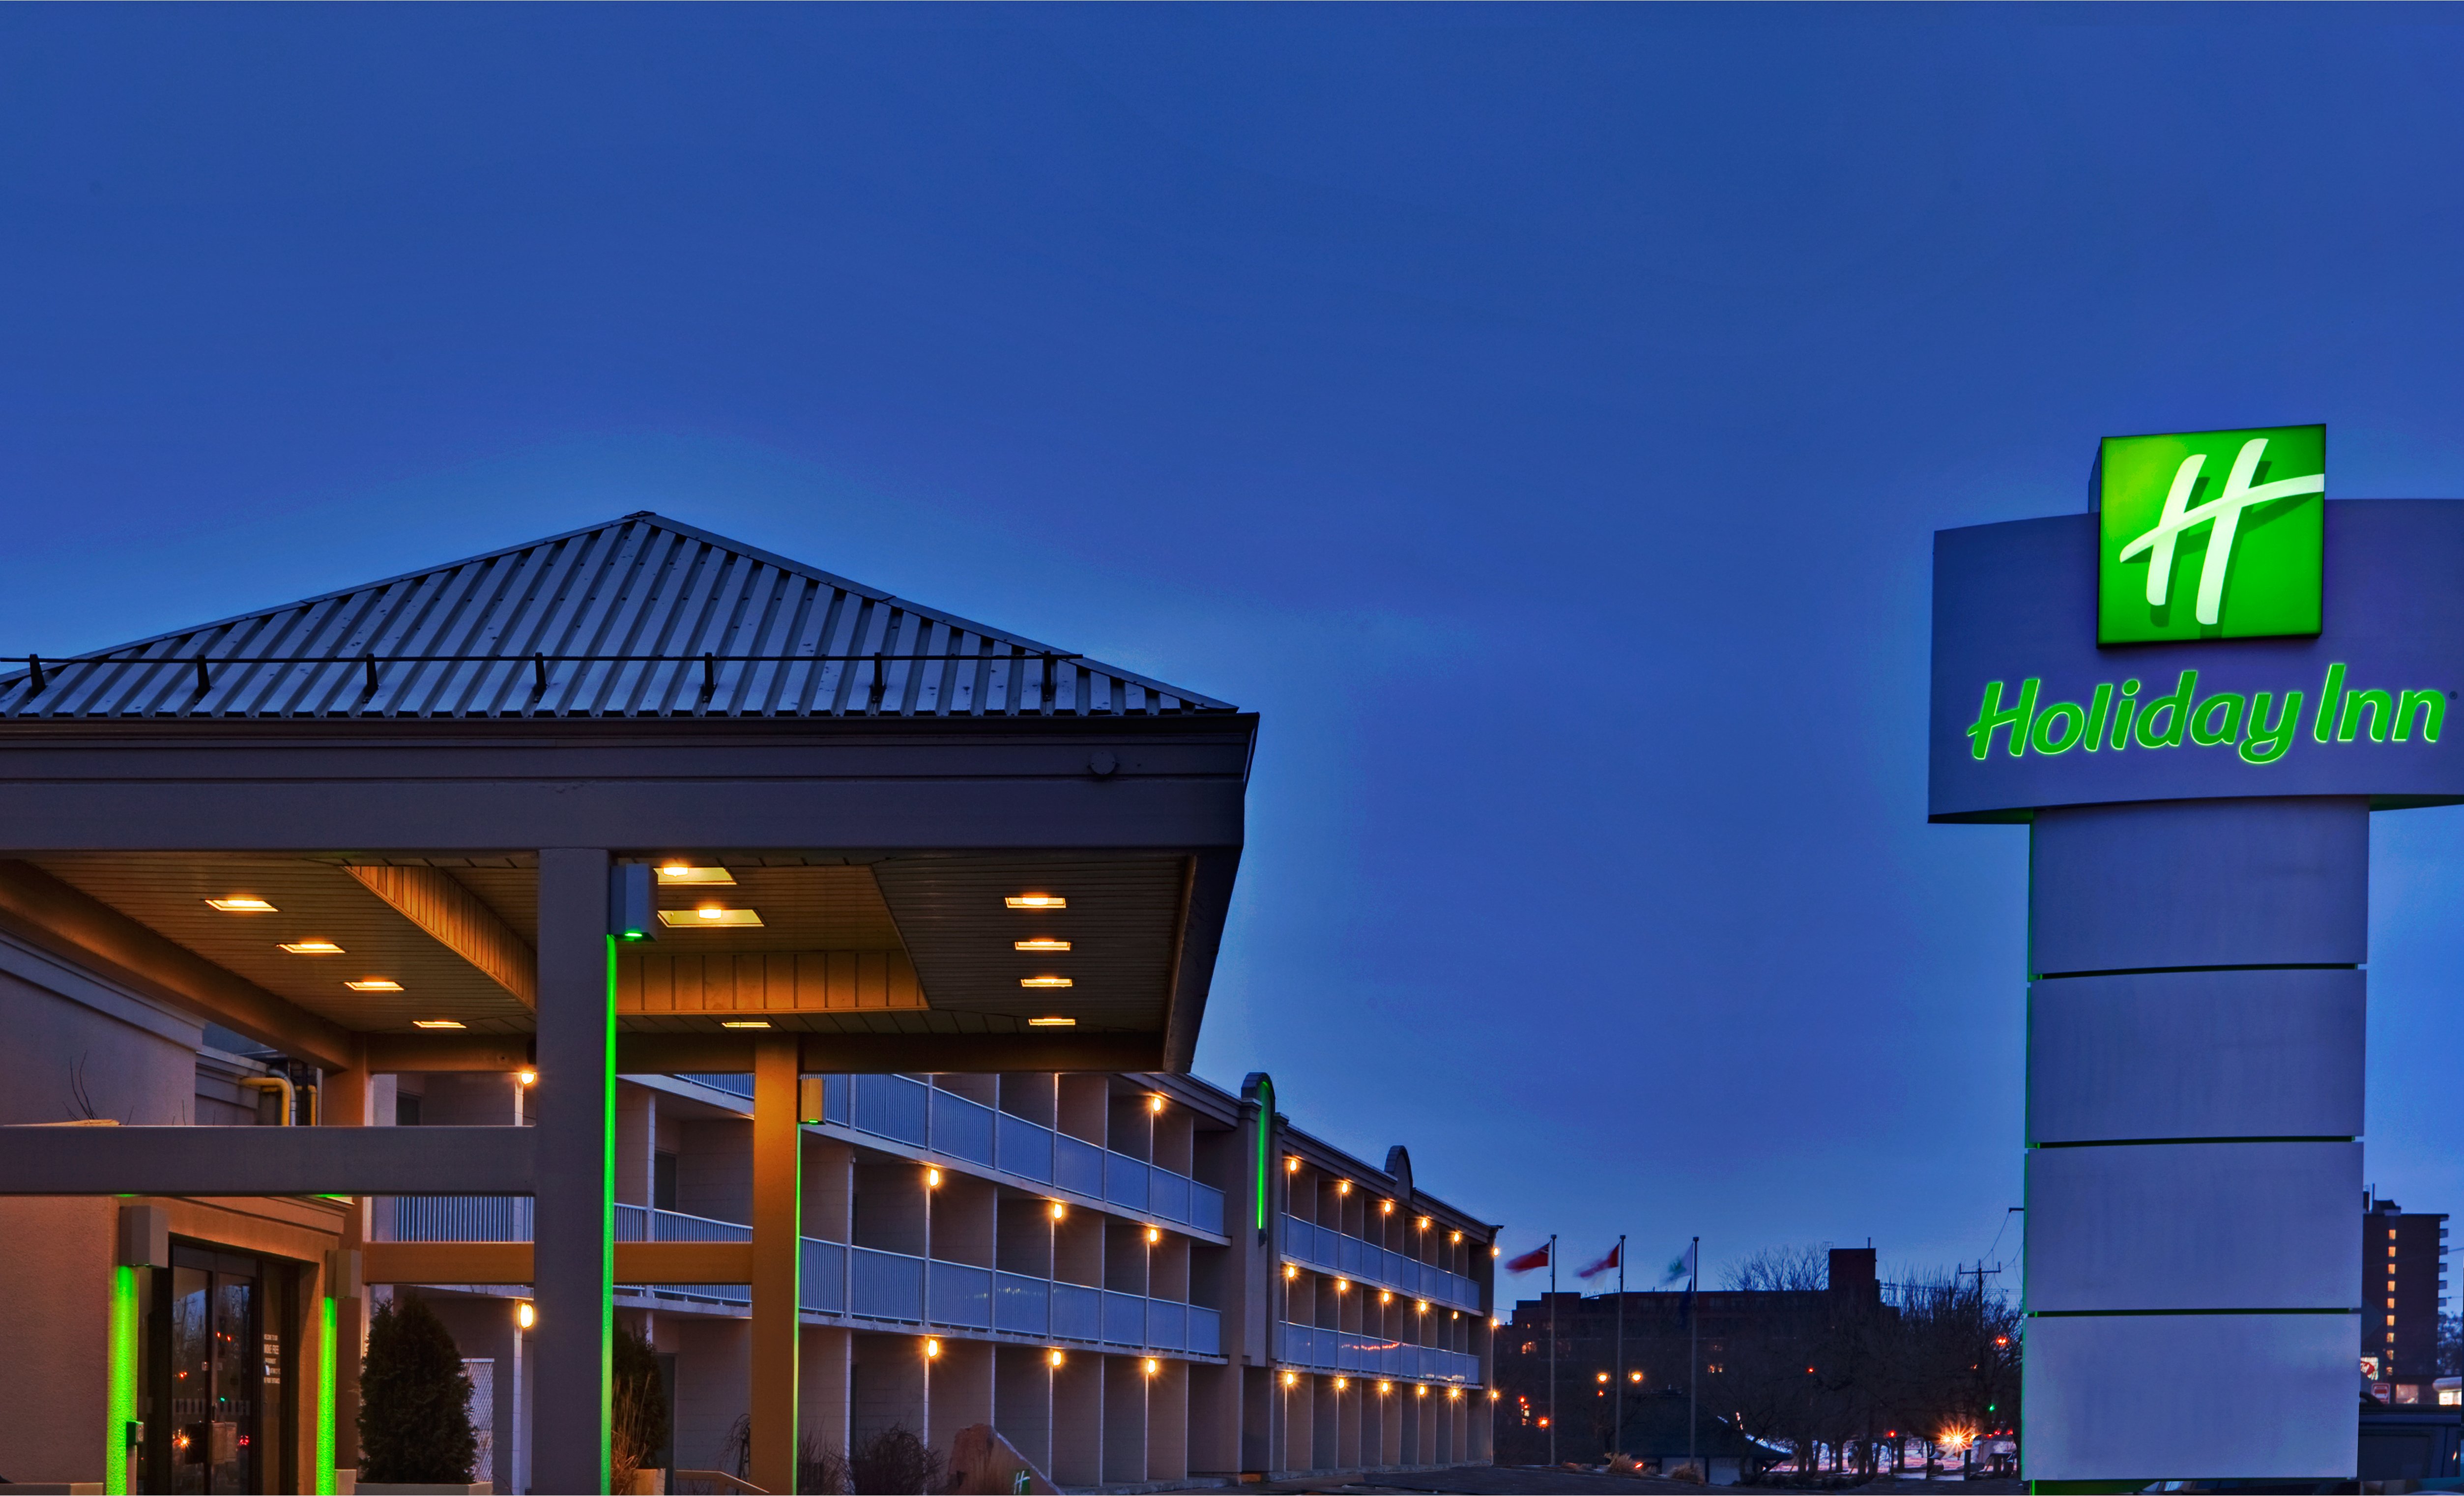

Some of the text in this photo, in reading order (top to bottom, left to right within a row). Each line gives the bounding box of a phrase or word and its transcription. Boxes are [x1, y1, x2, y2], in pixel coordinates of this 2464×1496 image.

[2119, 438, 2325, 625] H
[1967, 663, 2446, 764] Holiday Inn
